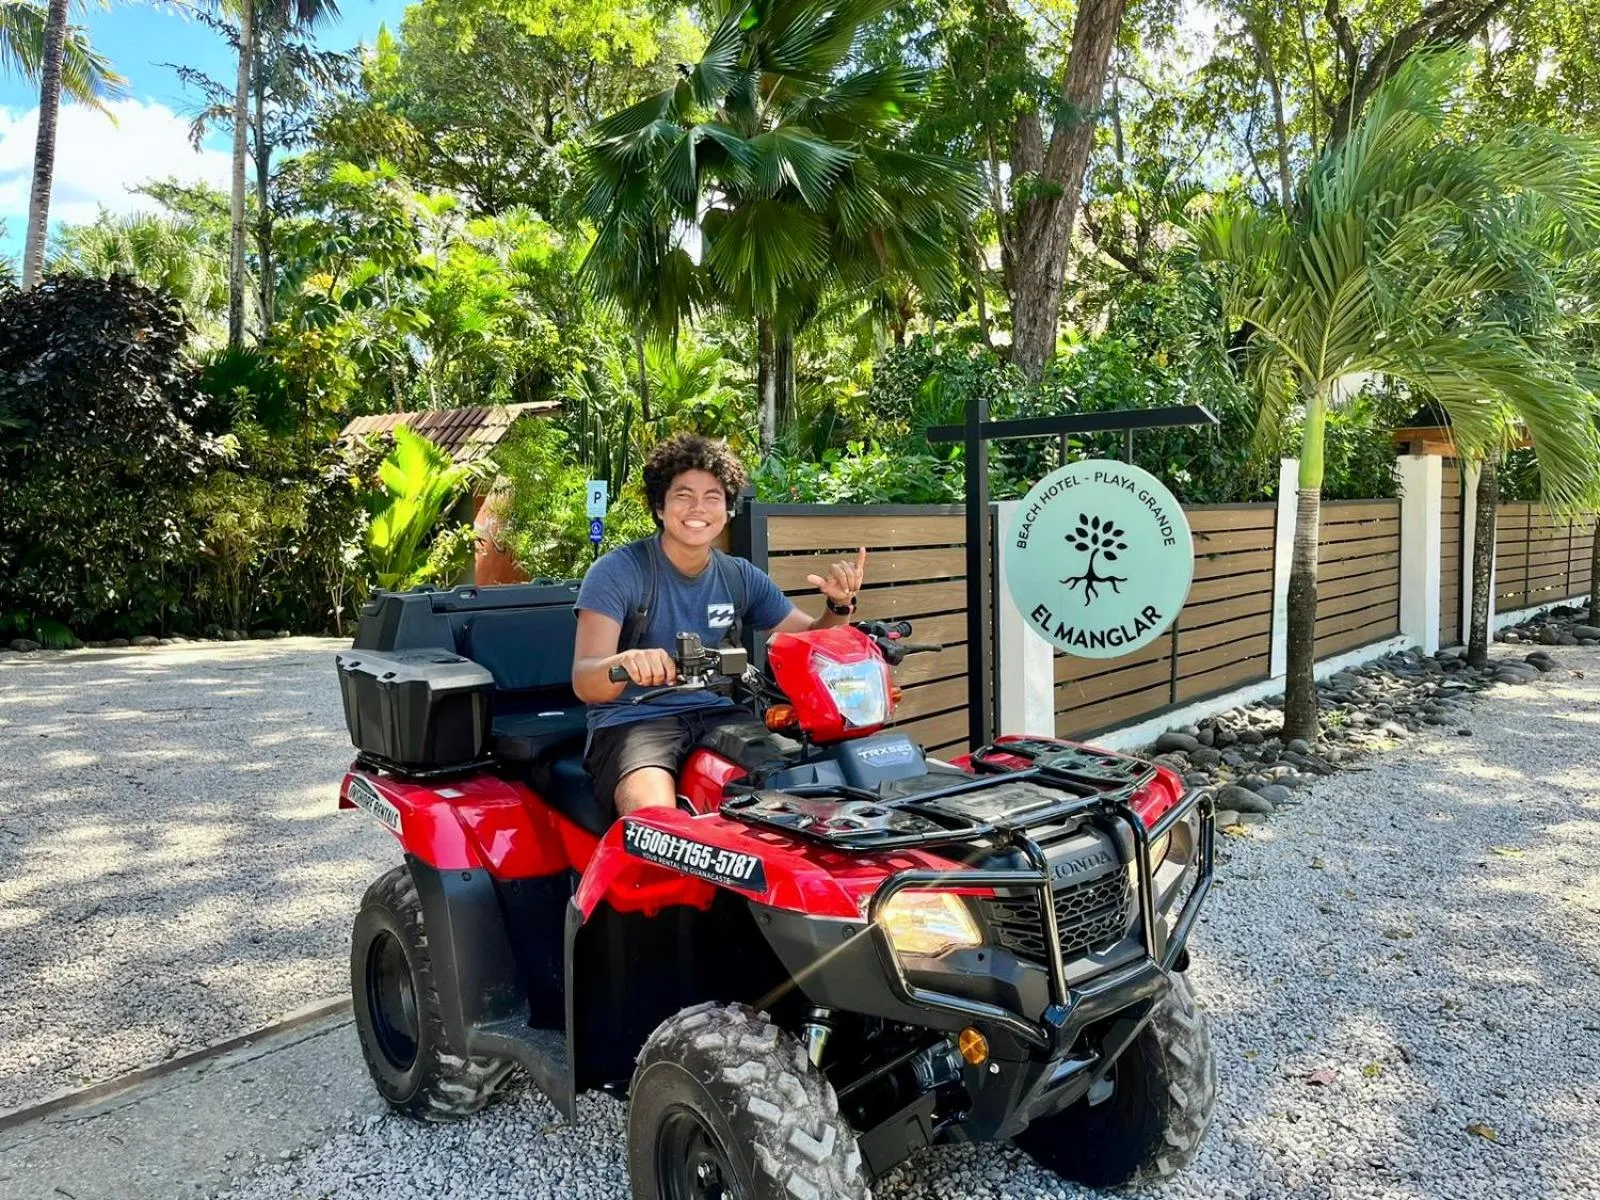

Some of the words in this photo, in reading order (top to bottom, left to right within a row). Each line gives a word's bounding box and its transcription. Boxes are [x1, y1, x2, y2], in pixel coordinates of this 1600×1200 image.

[594, 491, 602, 504] P
[1017, 503, 1042, 549] BEACH
[1039, 475, 1081, 505] HOTEL
[1094, 471, 1135, 494] PLAYA
[1138, 490, 1176, 547] GRANDE
[1030, 603, 1053, 632] EL
[1053, 605, 1163, 649] MANGLAR
